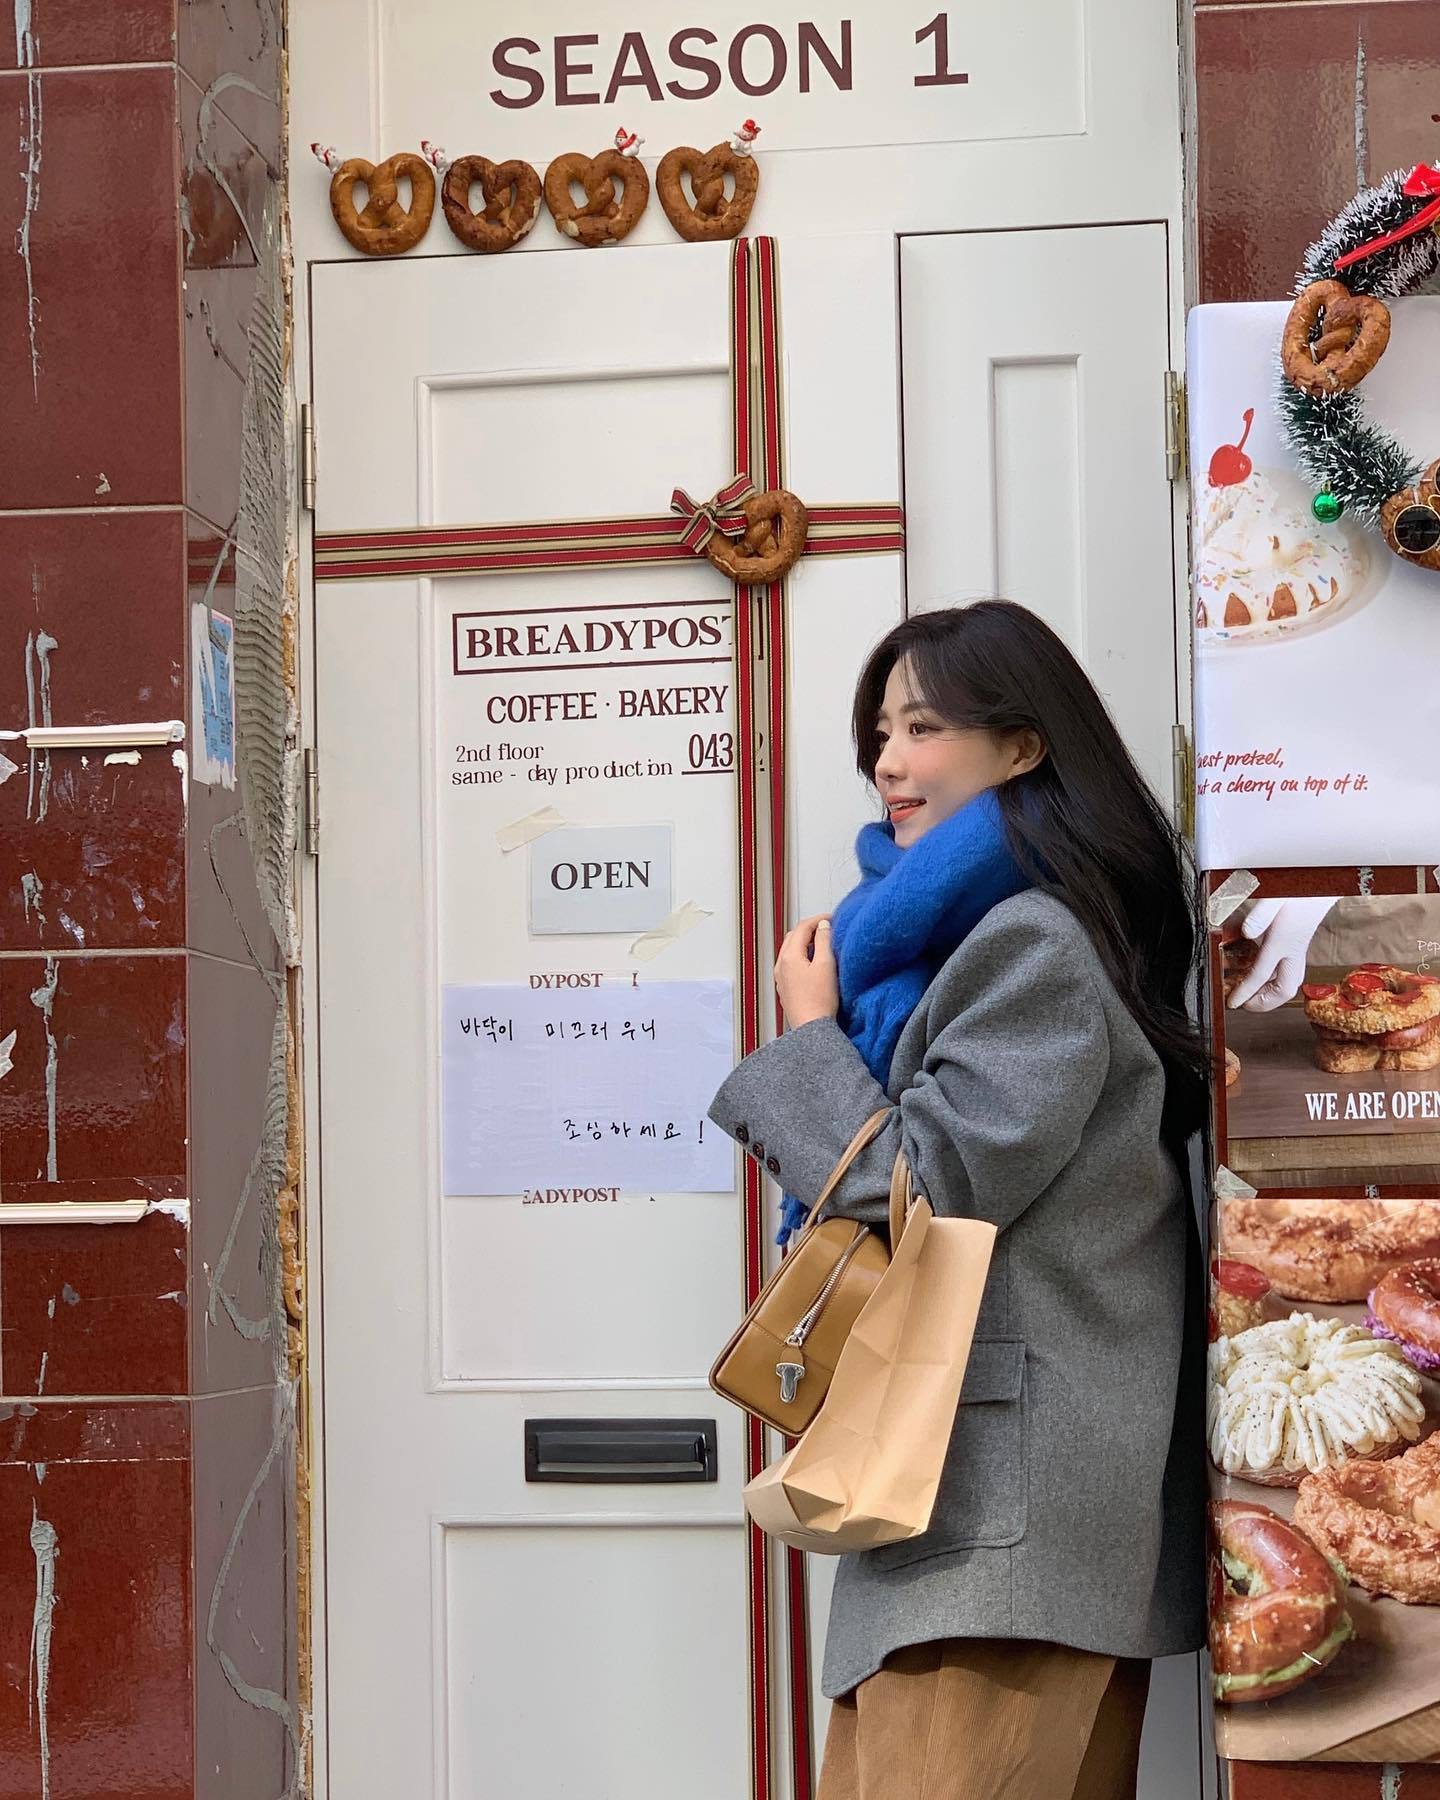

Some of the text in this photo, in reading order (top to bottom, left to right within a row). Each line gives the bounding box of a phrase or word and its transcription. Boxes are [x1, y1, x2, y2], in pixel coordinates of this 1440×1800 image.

[489, 12, 969, 109] SEASON 1
[486, 691, 598, 725] COFFEE
[618, 685, 729, 719] BAKERY
[456, 743, 545, 763] 2nd floor
[1222, 747, 1284, 773] pretzel,
[452, 769, 503, 786] same
[528, 764, 558, 786] day
[1210, 781, 1223, 793] a
[1226, 774, 1276, 801] cherry
[1304, 775, 1329, 797] top
[1333, 773, 1352, 795] of
[1353, 774, 1368, 791] it.
[550, 861, 652, 891] OPEN
[460, 1016, 513, 1042] 바닥이
[1304, 1092, 1339, 1121] WE
[1343, 1091, 1387, 1120] ARE
